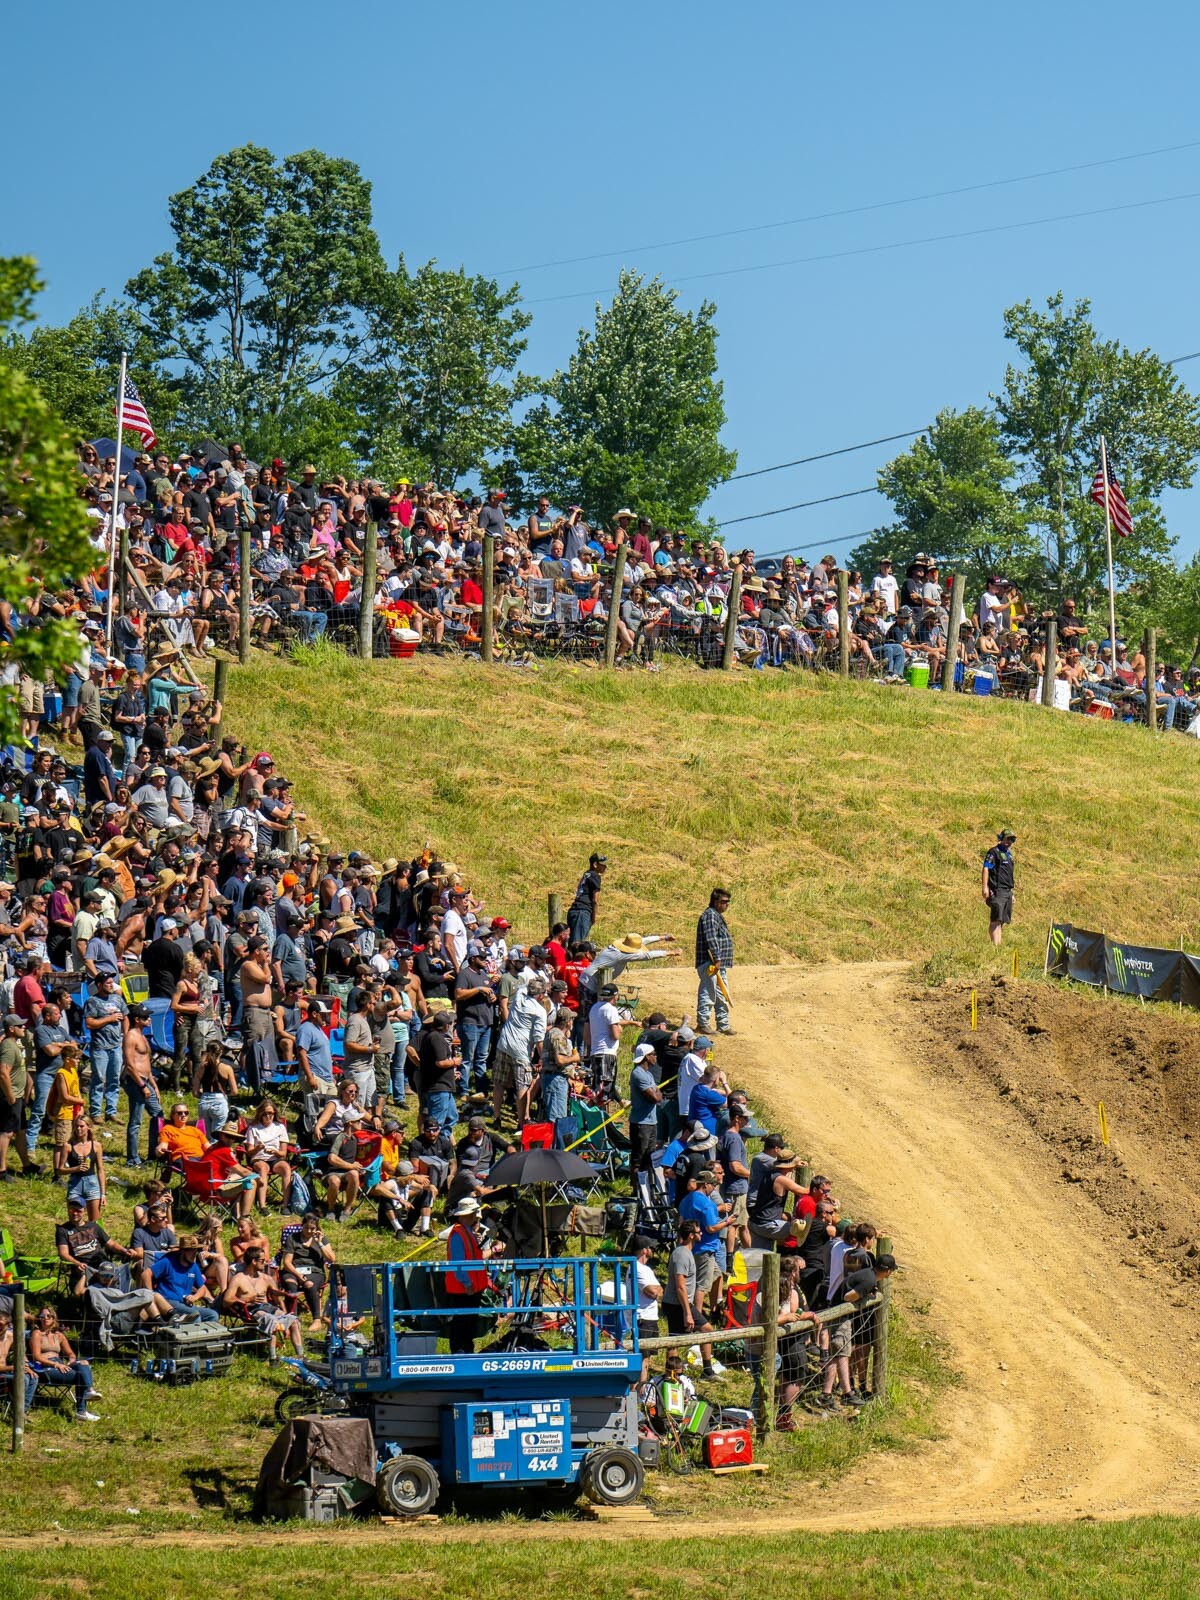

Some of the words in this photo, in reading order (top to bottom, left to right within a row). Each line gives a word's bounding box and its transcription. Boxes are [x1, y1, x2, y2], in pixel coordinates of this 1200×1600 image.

[1123, 957, 1154, 972] MONSTER
[343, 1363, 360, 1374] United
[400, 1366, 454, 1374] 1-800-UR-RENTS
[482, 1359, 530, 1371] GS-2669
[532, 1359, 547, 1370] RT
[528, 1456, 558, 1472] 4x4
